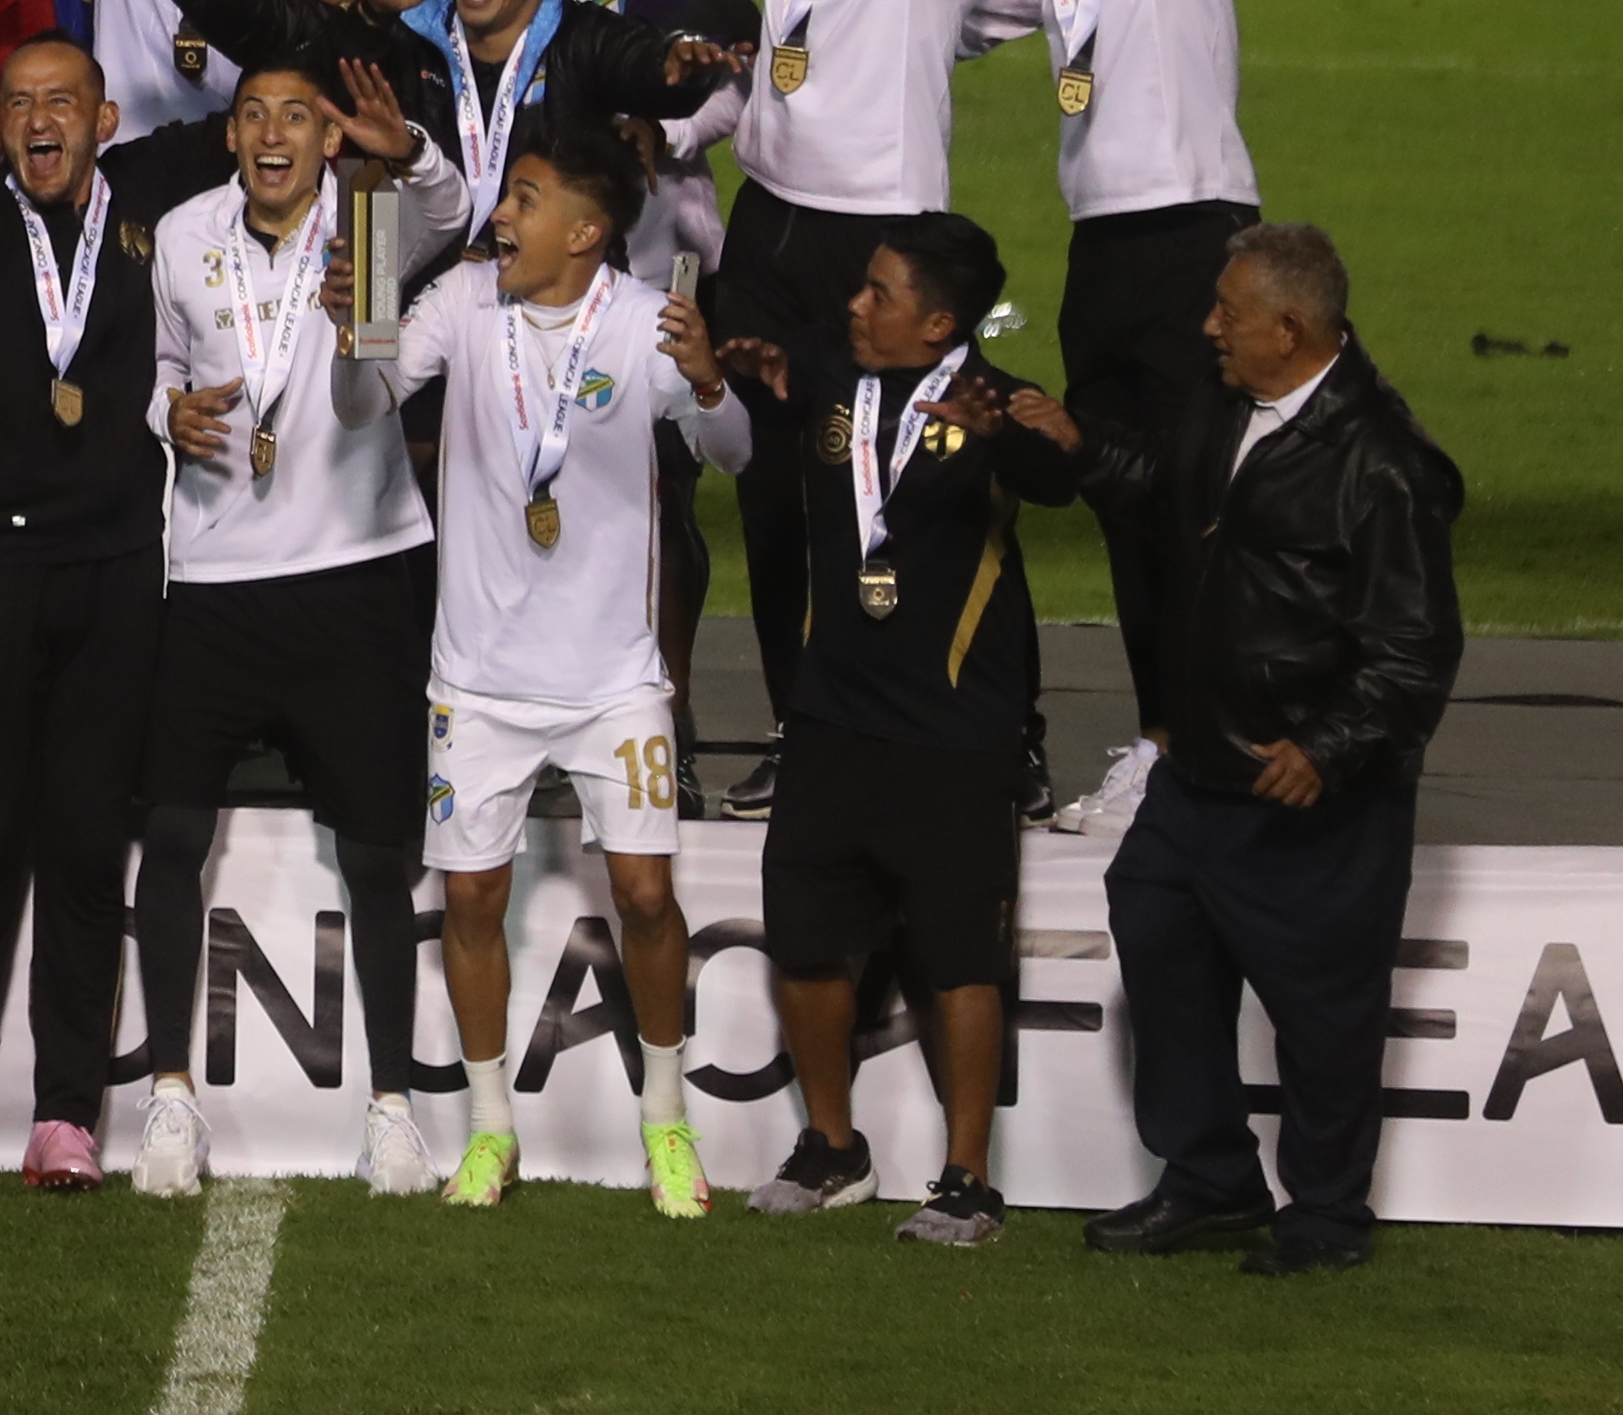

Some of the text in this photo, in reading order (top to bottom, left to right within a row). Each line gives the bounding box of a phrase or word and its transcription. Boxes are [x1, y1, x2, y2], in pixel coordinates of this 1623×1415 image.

[202, 250, 225, 289] 3
[287, 255, 311, 314] CONCACAF
[71, 277, 90, 322] LEAGUE
[277, 312, 297, 360] LEAGUE
[563, 334, 586, 394] CONCACAF
[553, 393, 572, 439] LEAGUE
[859, 380, 875, 437] CONCACAF
[613, 735, 676, 811] 18
